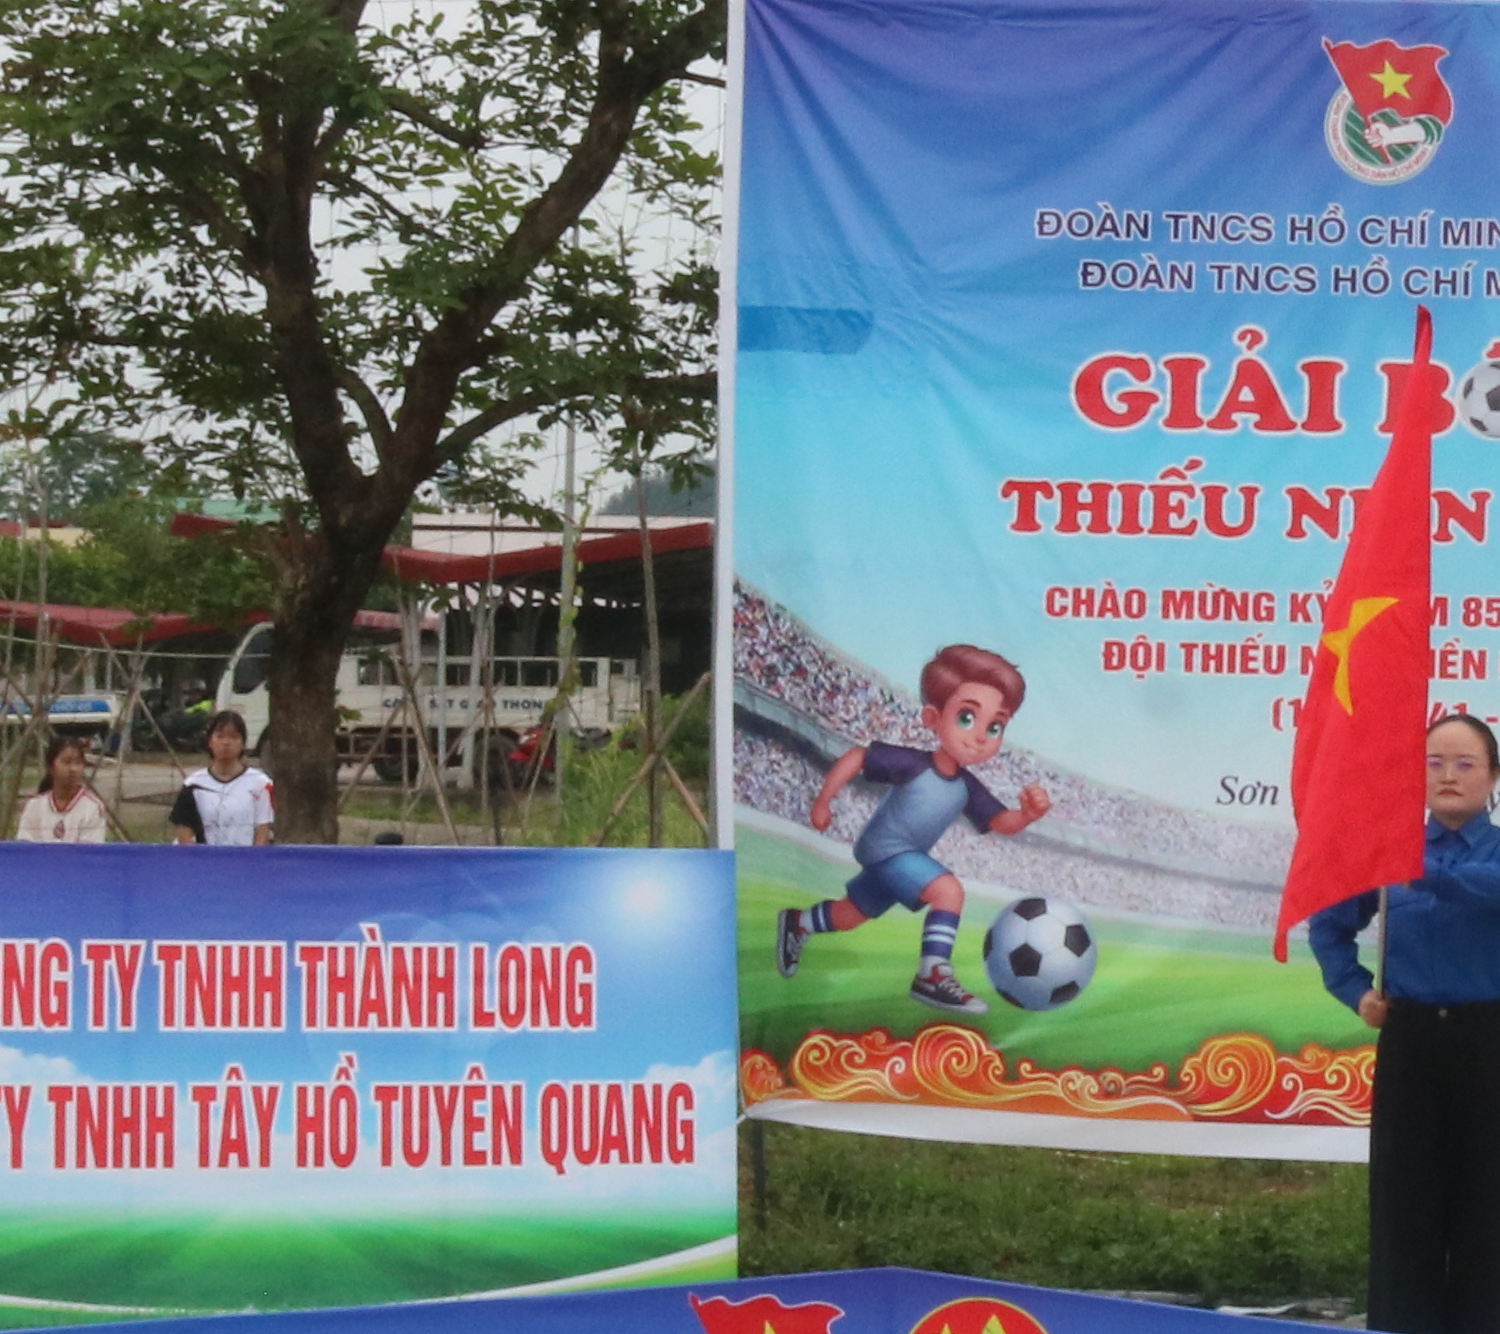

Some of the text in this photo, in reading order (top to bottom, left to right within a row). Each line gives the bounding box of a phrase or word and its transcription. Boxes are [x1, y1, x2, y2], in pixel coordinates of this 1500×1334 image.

[1037, 203, 1149, 240] ĐOÀN
[1164, 212, 1273, 242] TNCS
[1289, 203, 1346, 244] HỒ
[1359, 210, 1433, 246] CHÍ
[1080, 254, 1194, 290] ĐOÀN
[1209, 263, 1317, 293] TNCS
[1333, 254, 1390, 295] HỒ
[1403, 261, 1477, 297] CHÍ
[1074, 327, 1345, 432] GIẢI
[1000, 458, 1261, 538] THIẾU
[1284, 486, 1492, 544] NN
[1045, 581, 1148, 620] CHÀO
[1161, 582, 1276, 623] MỪNG
[1102, 634, 1166, 679] ĐỘI
[1180, 633, 1286, 675] THIẾU
[1216, 775, 1279, 806] Sơn
[86, 944, 142, 1027] TY
[157, 944, 283, 1028] TNHH
[300, 926, 457, 1028] THÀNH
[472, 944, 594, 1028] LONG
[48, 1085, 175, 1169] TNHH
[192, 1067, 280, 1168] TÂY
[296, 1054, 358, 1168] HỒ
[374, 1066, 523, 1167] TUYÊN
[540, 1081, 695, 1175] QUANG
